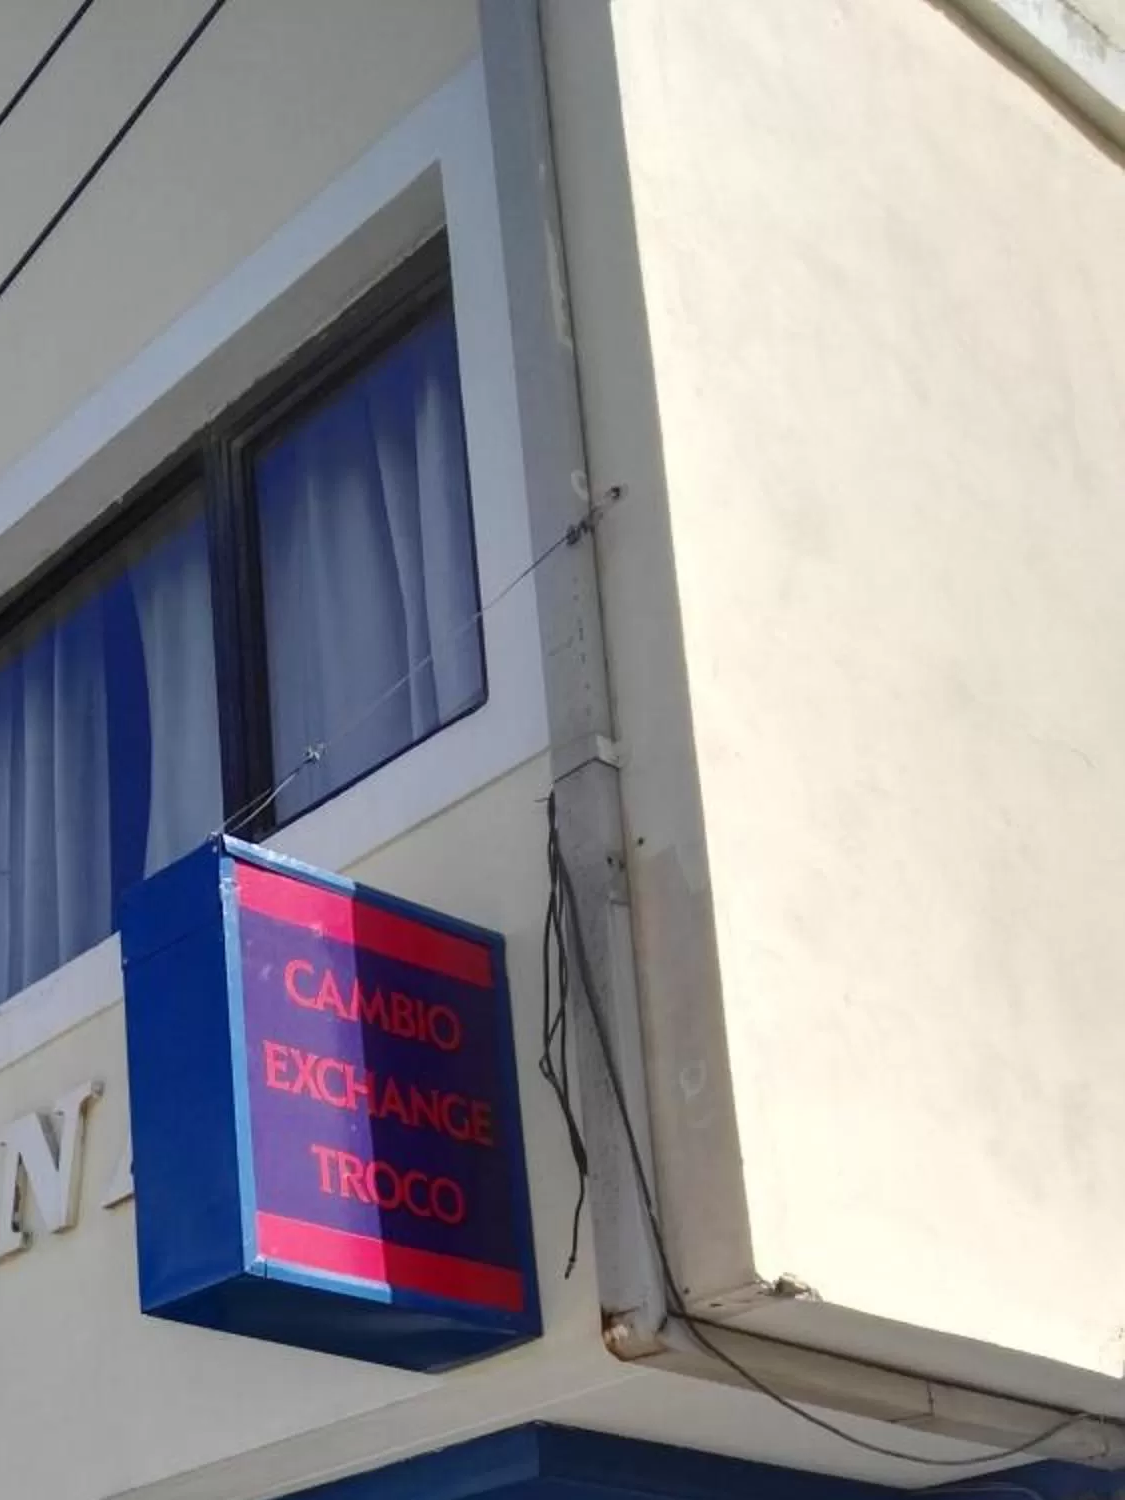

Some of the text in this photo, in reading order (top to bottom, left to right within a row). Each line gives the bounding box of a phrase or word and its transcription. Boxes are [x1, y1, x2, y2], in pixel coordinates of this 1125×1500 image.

[283, 958, 462, 1050] CAMBIO
[262, 1038, 494, 1146] EXCHANGE
[311, 1144, 467, 1225] TROCO
